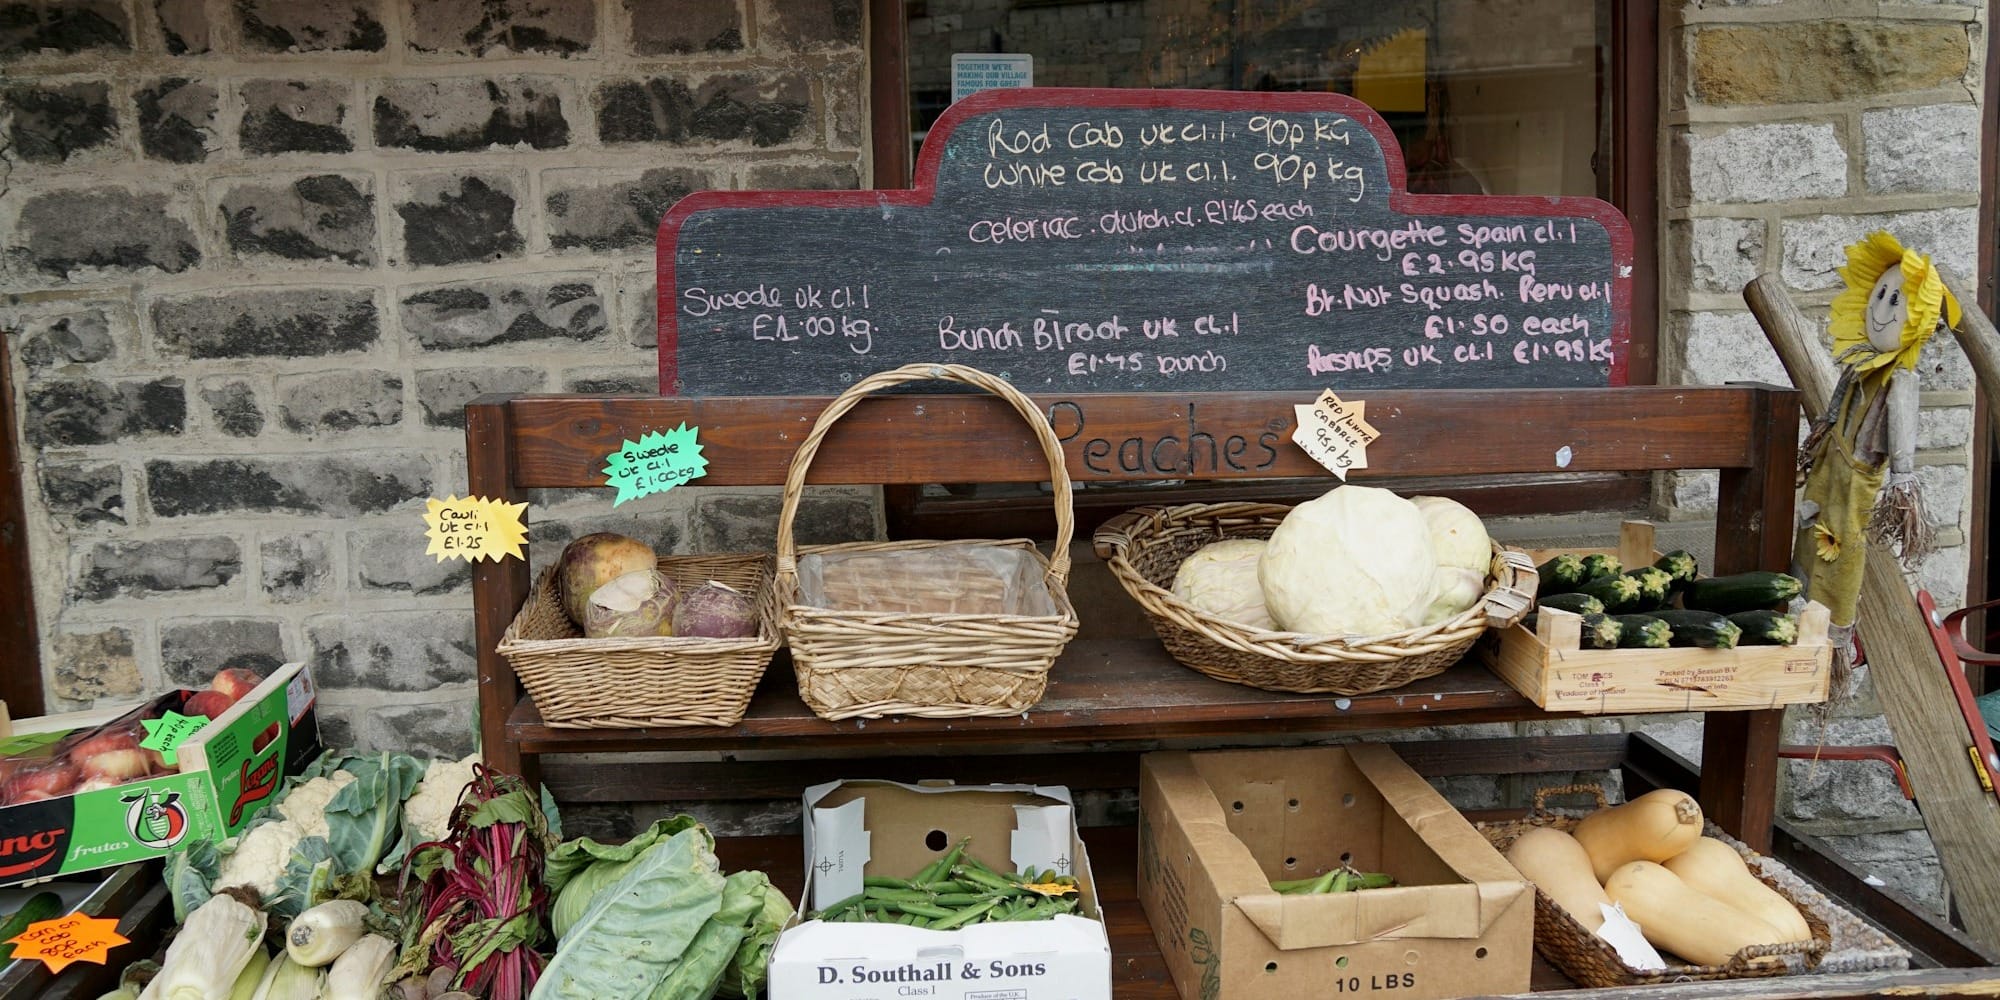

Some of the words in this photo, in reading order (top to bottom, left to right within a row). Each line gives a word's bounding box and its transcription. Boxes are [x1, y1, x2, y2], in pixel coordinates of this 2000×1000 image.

[1249, 116, 1304, 150] 90p
[1254, 153, 1317, 189] 90p
[1291, 220, 1448, 261] Courgette
[683, 284, 783, 317] Swede
[1519, 274, 1573, 304] Peru
[938, 315, 1023, 350] Bunch
[1523, 312, 1589, 338] each
[1049, 401, 1281, 476] Peaches
[623, 443, 680, 464] Swede
[440, 508, 479, 521] Cauli
[1659, 669, 1685, 677] Packed
[1559, 689, 1588, 698] Produce
[68, 841, 129, 862] frutas
[63, 940, 107, 959] each
[816, 965, 844, 985] D.
[851, 962, 952, 984] Southall
[961, 963, 981, 980] &
[990, 960, 1046, 978] Sons
[1335, 977, 1360, 994] 10
[1371, 973, 1416, 990] LBS
[897, 986, 929, 997] Class
